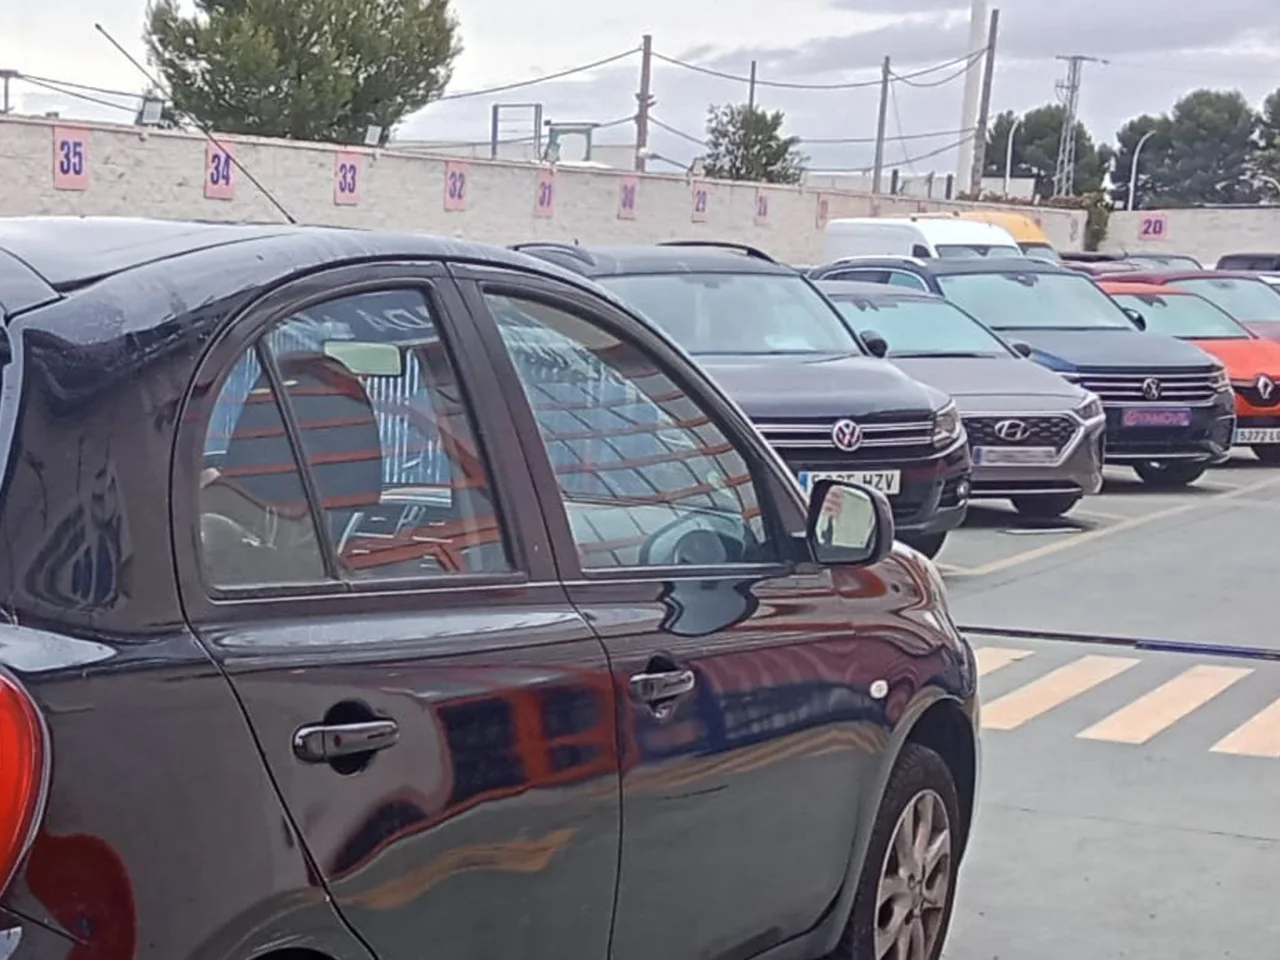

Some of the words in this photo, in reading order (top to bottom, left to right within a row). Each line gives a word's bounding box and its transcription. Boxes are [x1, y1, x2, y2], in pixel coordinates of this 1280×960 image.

[60, 140, 83, 175] 35
[210, 154, 231, 186] 34
[338, 163, 357, 193] 33
[449, 170, 465, 200] 32
[539, 182, 552, 208] 31
[1141, 219, 1163, 235] 20
